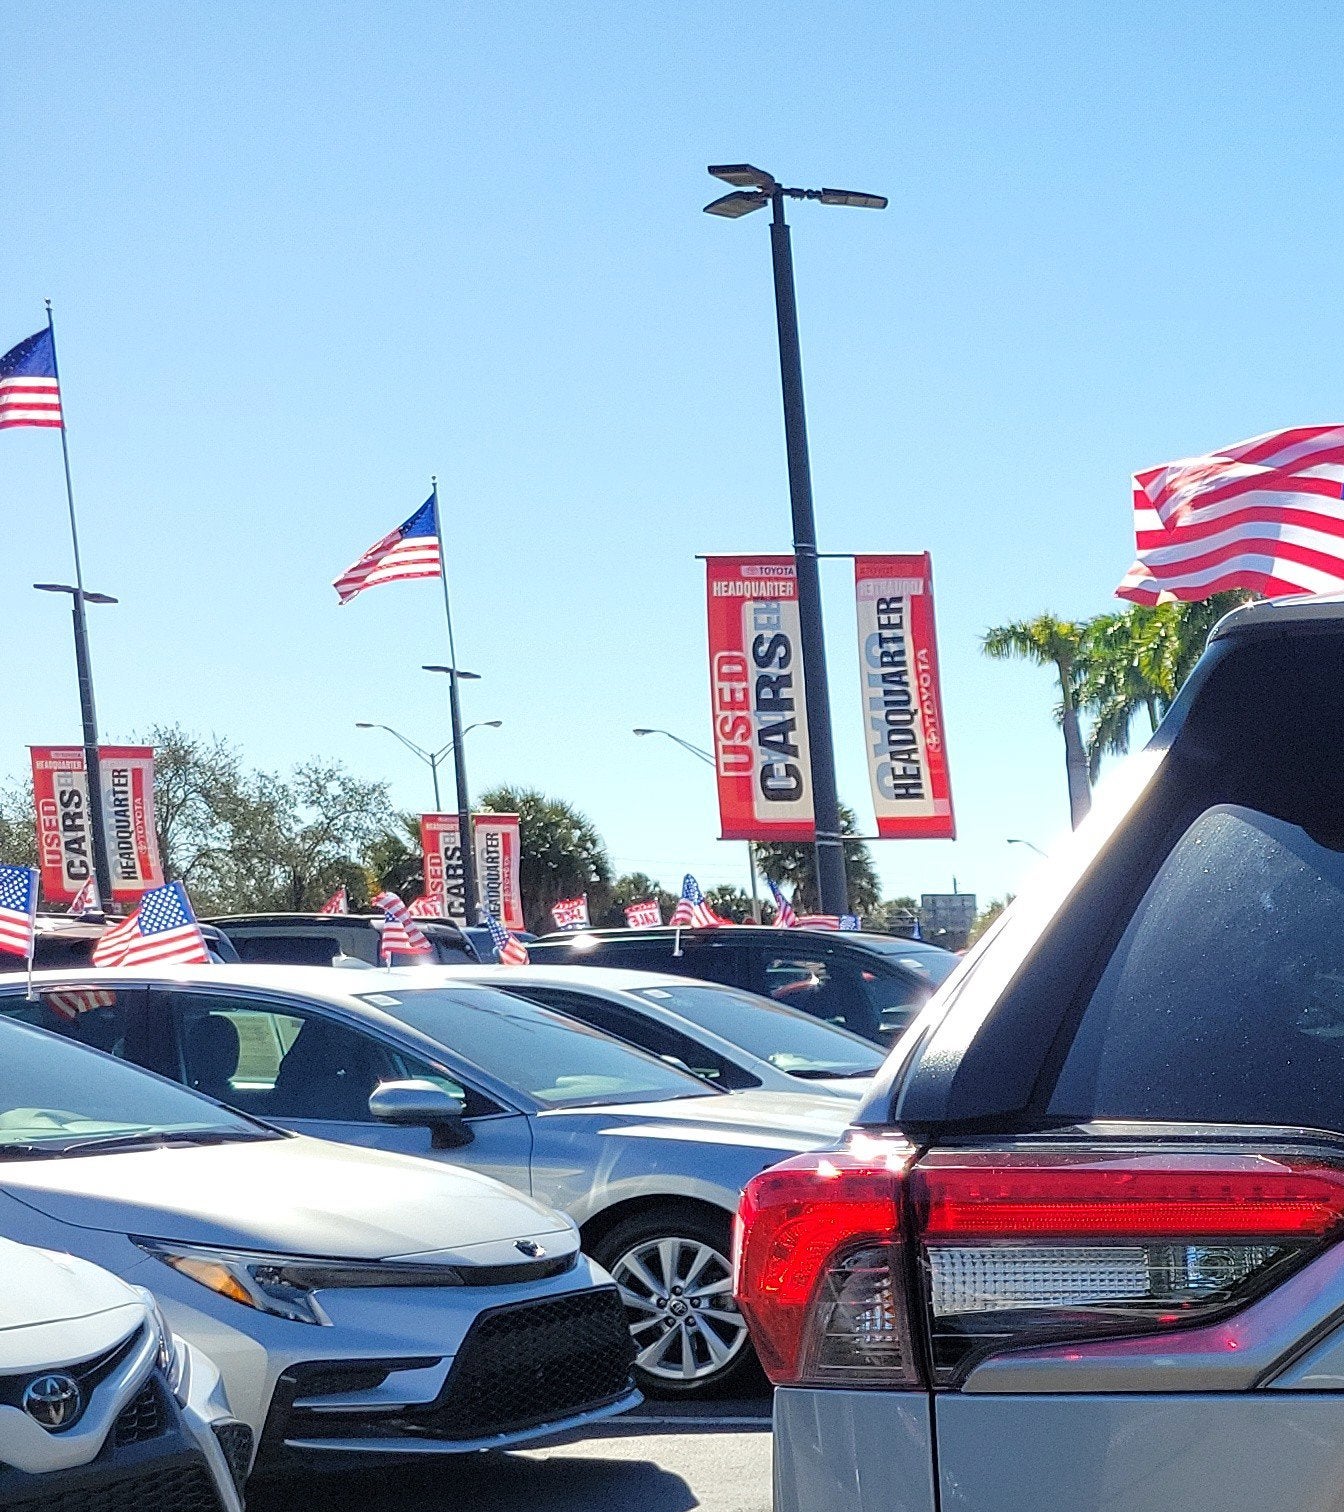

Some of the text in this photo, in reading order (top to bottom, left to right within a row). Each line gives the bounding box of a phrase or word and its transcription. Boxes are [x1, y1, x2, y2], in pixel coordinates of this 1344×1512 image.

[713, 581, 794, 597] HEADQUARTER
[759, 566, 794, 576] TOYOTA
[715, 653, 753, 775] USED
[752, 633, 803, 802] CARS
[877, 596, 925, 800] HEADQUARTER
[916, 648, 937, 725] TOYOTA
[41, 800, 62, 867] USED
[59, 788, 90, 881] CARS
[112, 768, 139, 880] HEADQUARTER
[134, 798, 145, 841] TOYOTA
[429, 854, 444, 893] SED
[444, 846, 466, 918] CARS
